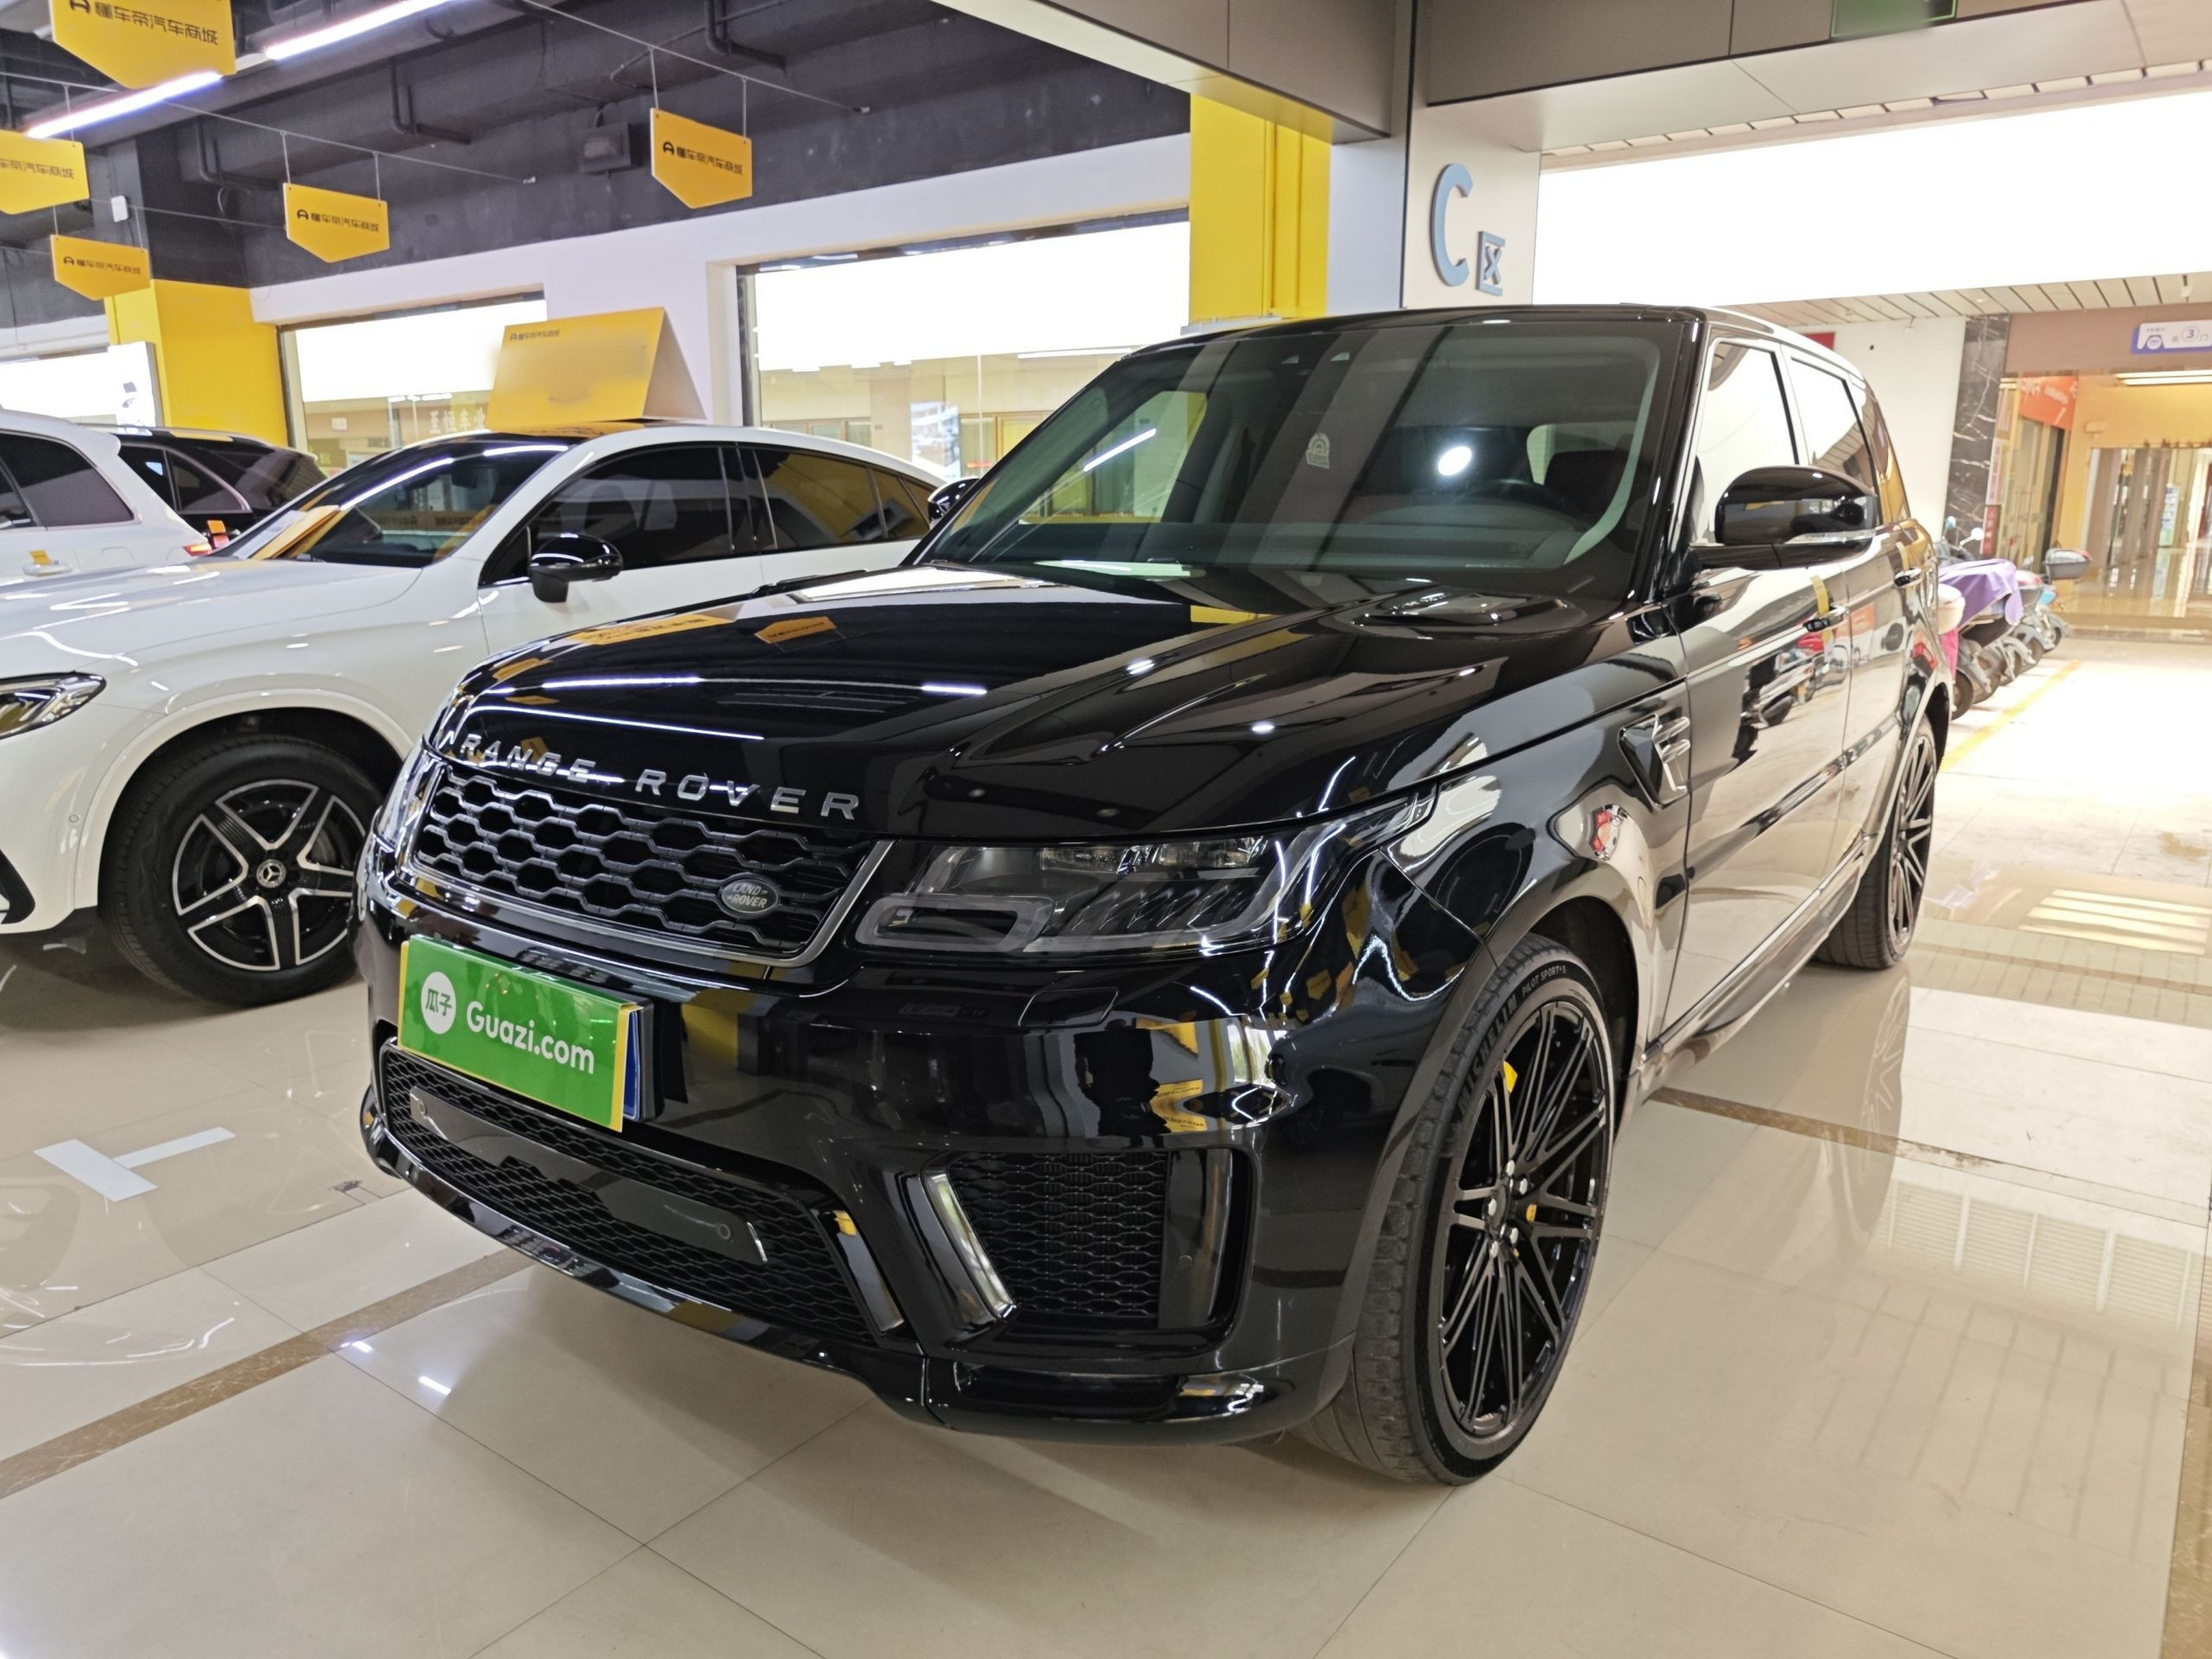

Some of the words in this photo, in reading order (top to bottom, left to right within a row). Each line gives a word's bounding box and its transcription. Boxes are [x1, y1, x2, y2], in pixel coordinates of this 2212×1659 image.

[95, 2, 218, 45] 懂车帝汽车商城
[460, 733, 596, 783] RANGE
[635, 768, 860, 821] ROVER
[732, 893, 767, 908] ROVER
[425, 988, 453, 1017] 瓜子
[1522, 974, 1539, 997] PILOT
[466, 1001, 594, 1075] Guazi.com
